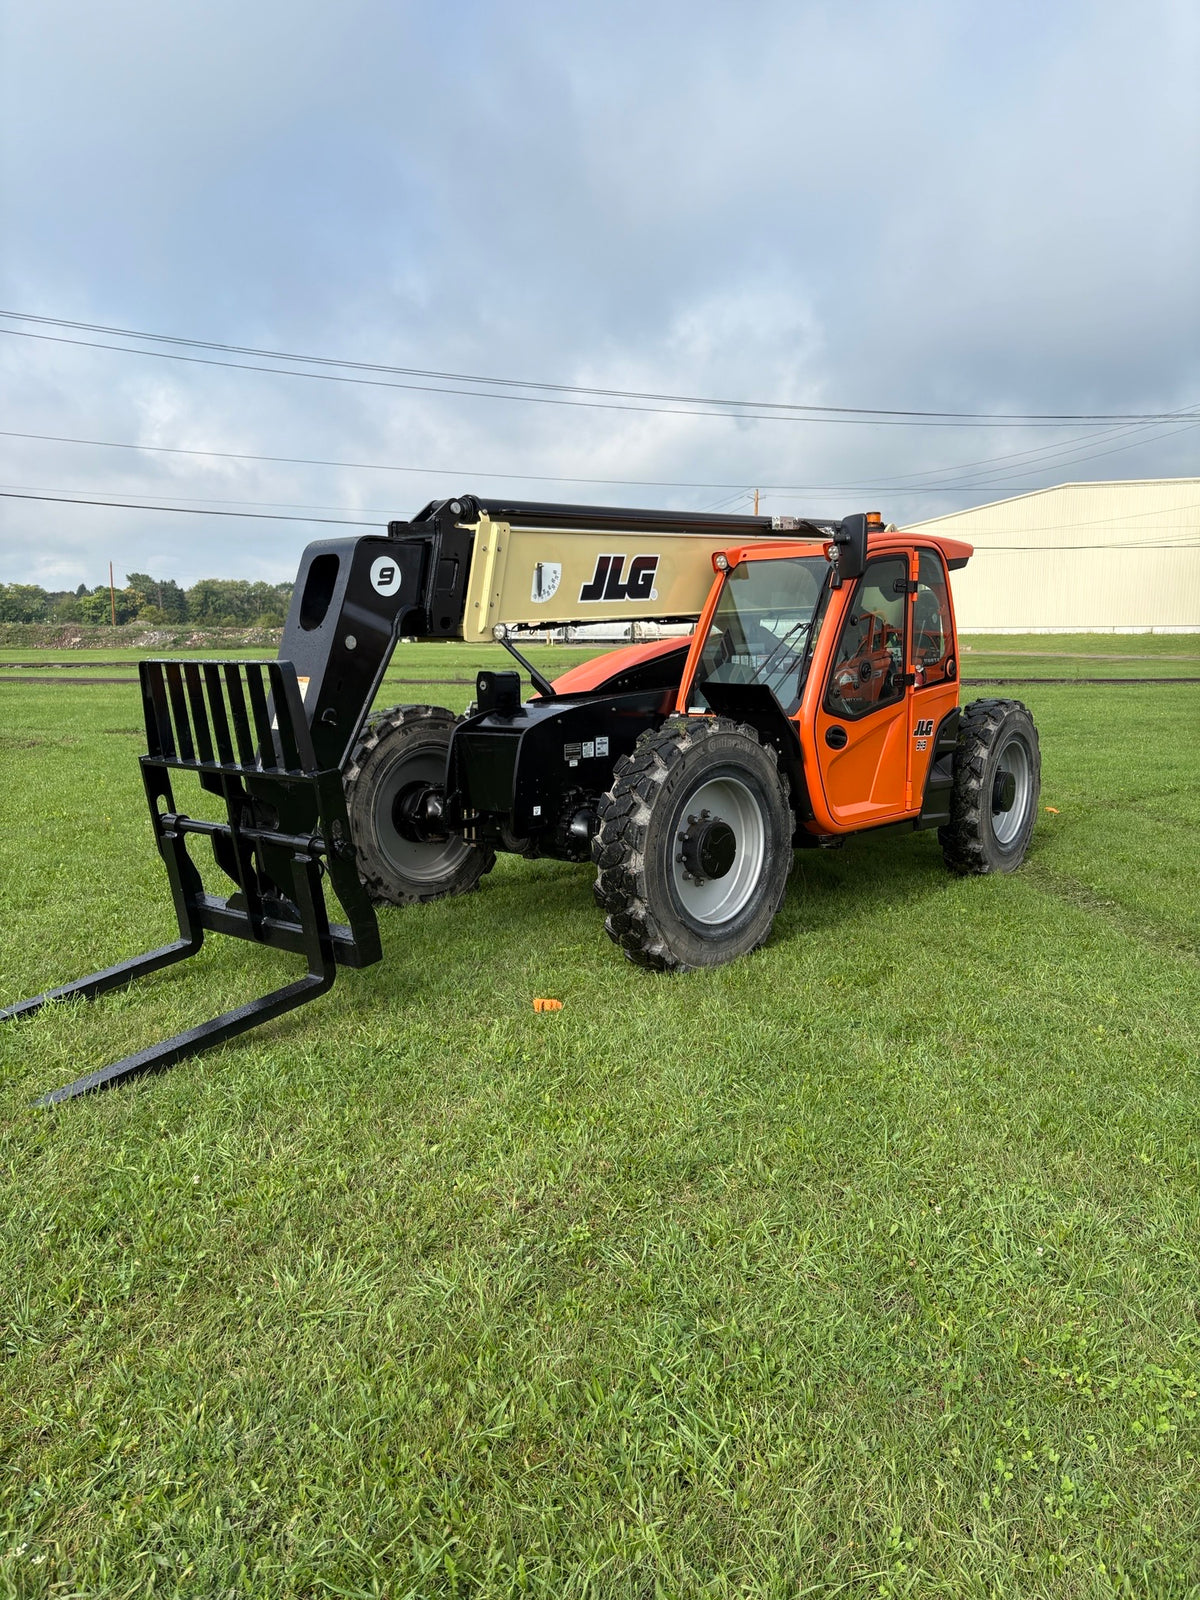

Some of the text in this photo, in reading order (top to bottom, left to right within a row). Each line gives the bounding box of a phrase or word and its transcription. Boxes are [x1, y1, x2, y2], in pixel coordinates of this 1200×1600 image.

[377, 567, 395, 586] 9
[579, 555, 660, 602] JLG
[913, 719, 934, 737] JLG
